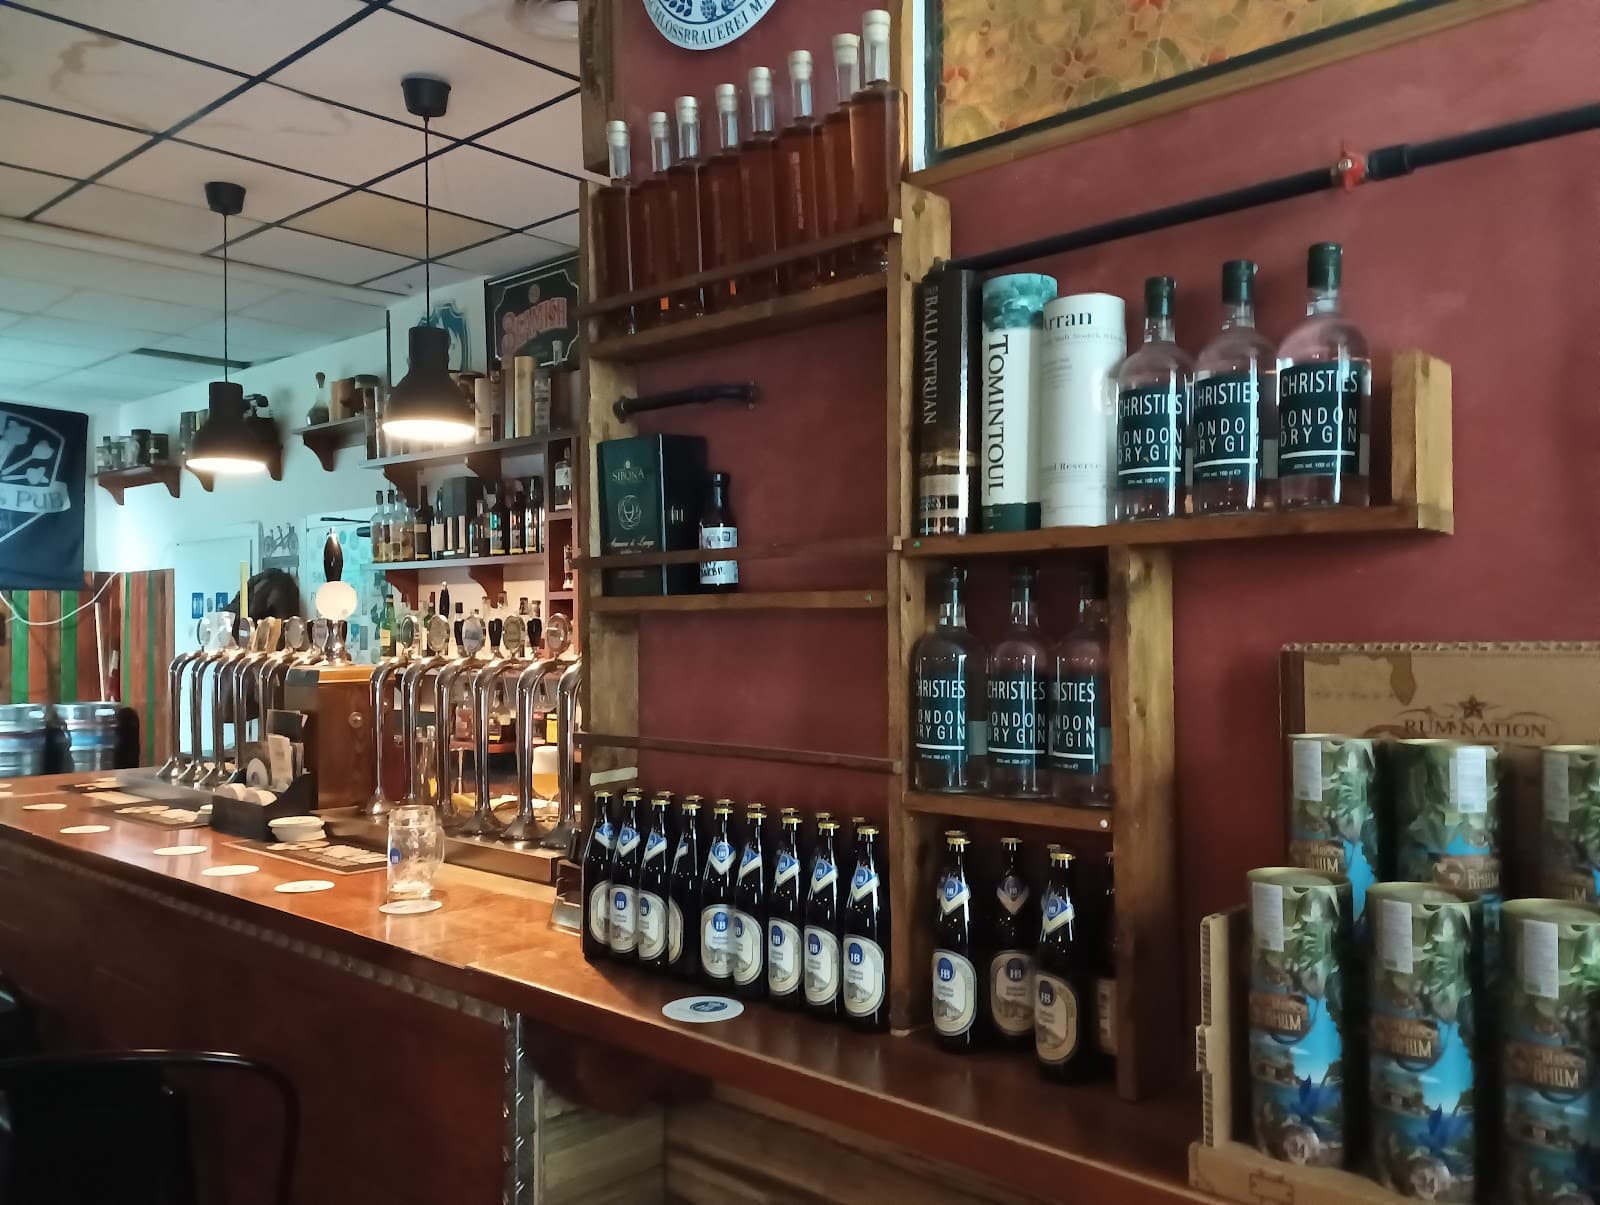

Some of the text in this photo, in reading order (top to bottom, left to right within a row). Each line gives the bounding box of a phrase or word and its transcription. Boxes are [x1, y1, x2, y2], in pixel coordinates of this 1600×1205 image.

[748, 0, 768, 17] M
[923, 296, 939, 425] BALLANTRUAN
[1196, 381, 1260, 409] HRISTIE
[988, 335, 1009, 496] TOMINTOUL
[1281, 406, 1357, 429] LONDON
[1197, 416, 1260, 439] ONDO
[1281, 425, 1357, 448] DRY GN
[1150, 444, 1182, 461] GIN
[1195, 437, 1216, 455] RY
[16, 489, 65, 510] PUB
[987, 680, 1046, 700] CHRISTIES
[1056, 681, 1096, 703] ISTIES
[917, 708, 966, 725] ONDON
[988, 711, 1046, 728] ONDON
[1055, 714, 1095, 732] NDON
[916, 724, 966, 740] RY GIN
[1016, 728, 1046, 744] GIN
[1404, 719, 1547, 738] RUM NATION
[1065, 731, 1095, 748] GIN
[1311, 857, 1339, 873] UM
[1268, 1012, 1301, 1031] HUM
[1394, 1036, 1432, 1058] HUM
